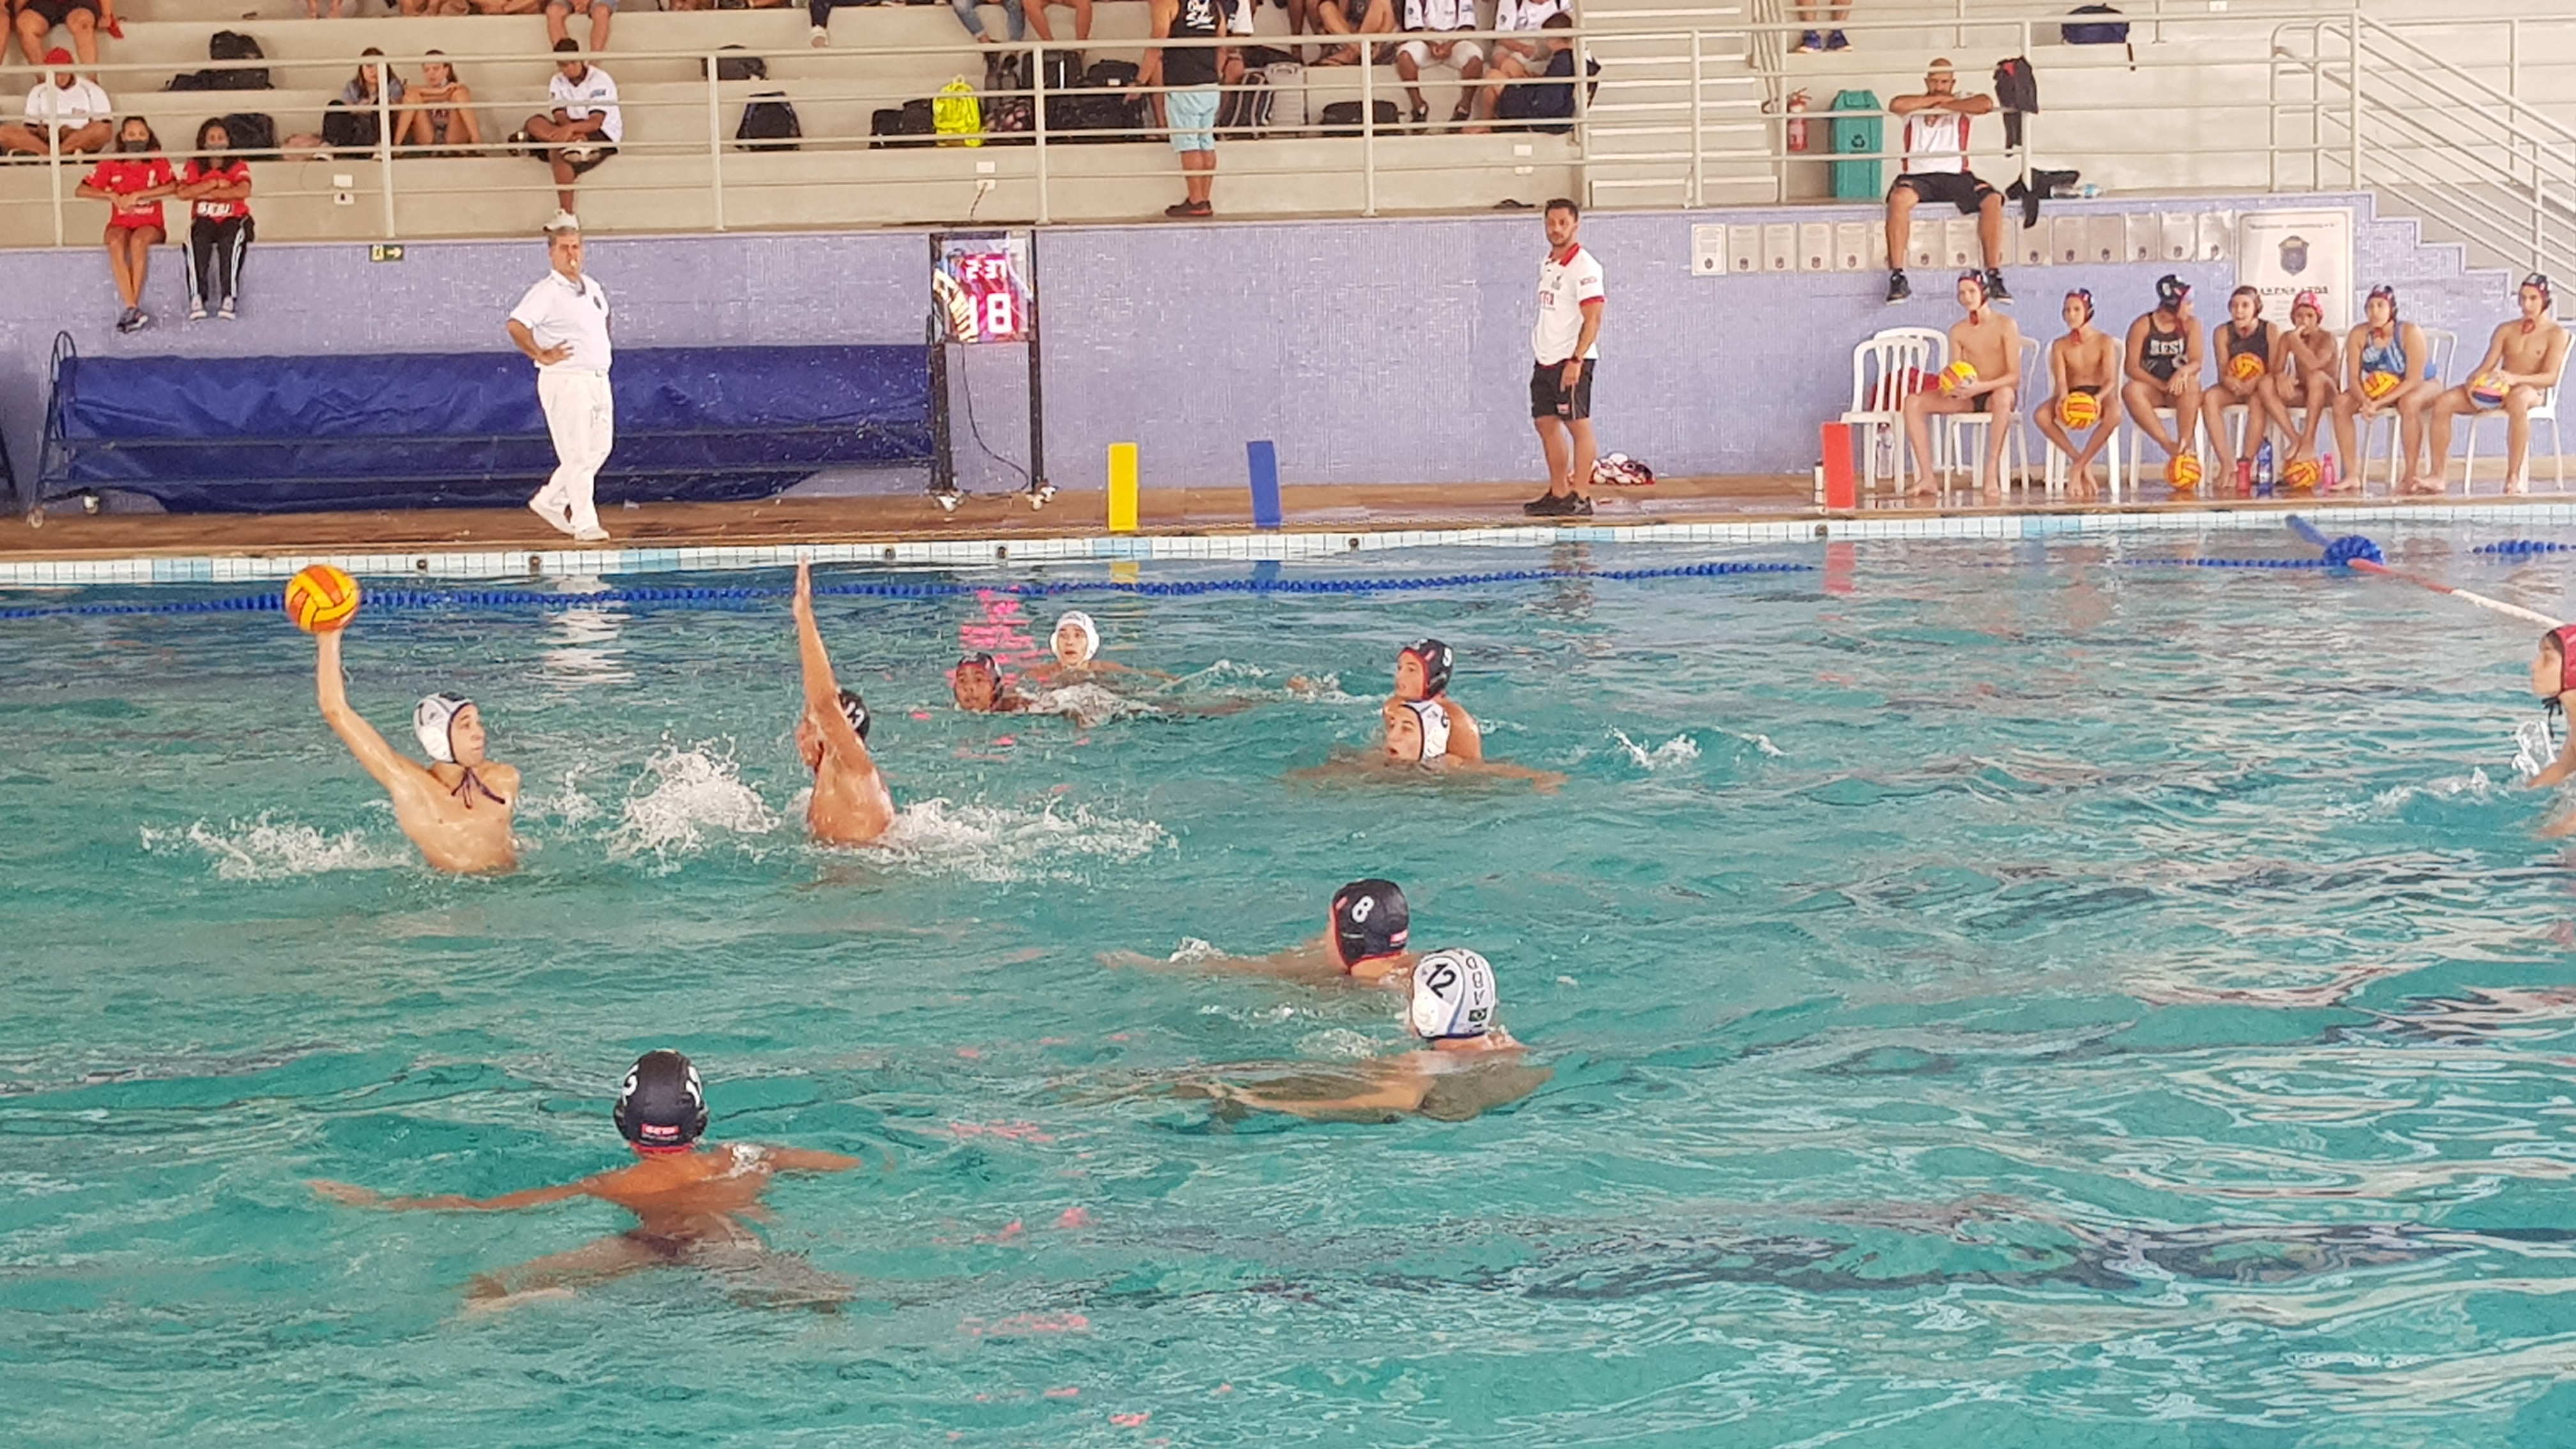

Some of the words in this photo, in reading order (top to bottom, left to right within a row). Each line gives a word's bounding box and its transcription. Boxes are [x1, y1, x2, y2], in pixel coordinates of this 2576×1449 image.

[968, 293, 1012, 337] 18
[1351, 895, 1374, 923] 8
[1426, 963, 1457, 999] 12
